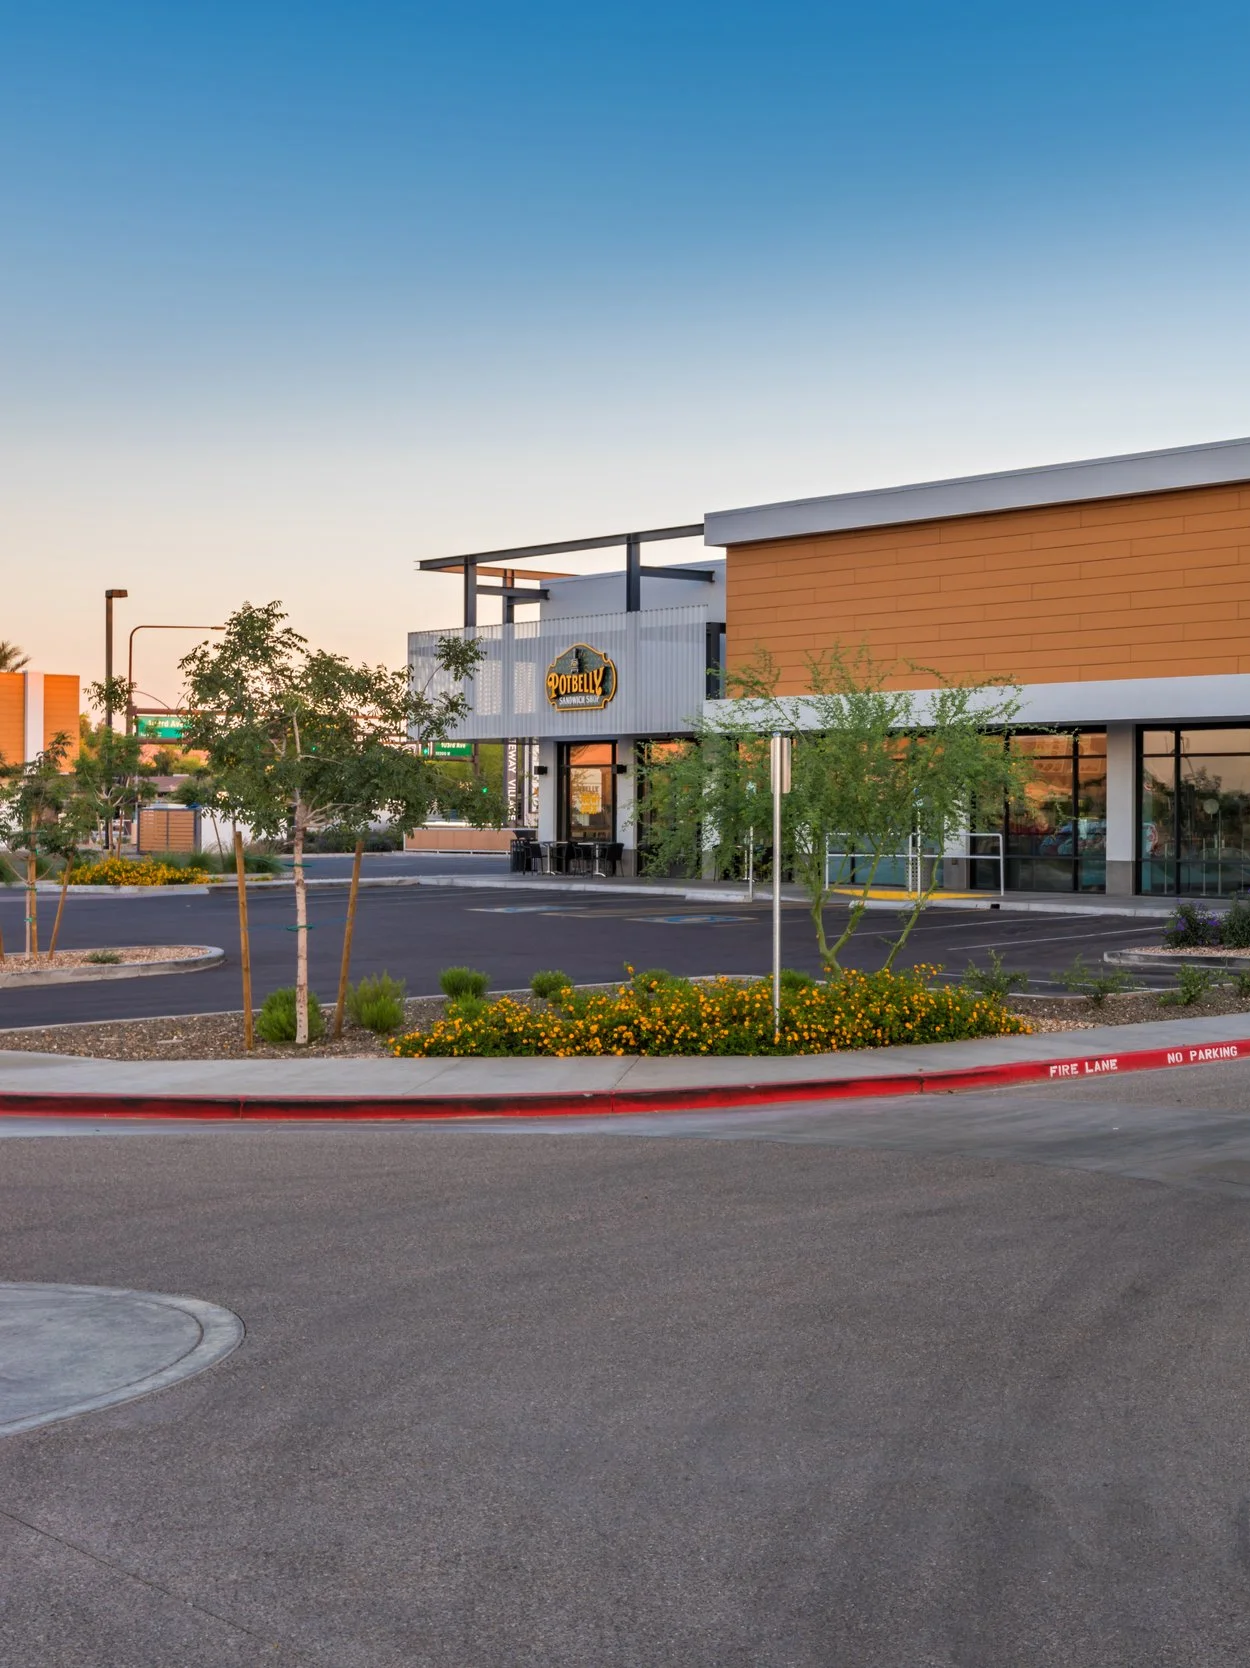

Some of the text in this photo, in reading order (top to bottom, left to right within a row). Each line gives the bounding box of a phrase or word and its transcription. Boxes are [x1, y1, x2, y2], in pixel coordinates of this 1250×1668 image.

[547, 666, 605, 699] POTBELLY
[558, 696, 585, 705] SANDWICH
[1050, 1046, 1238, 1077] FIRE LANE NO PARKING
